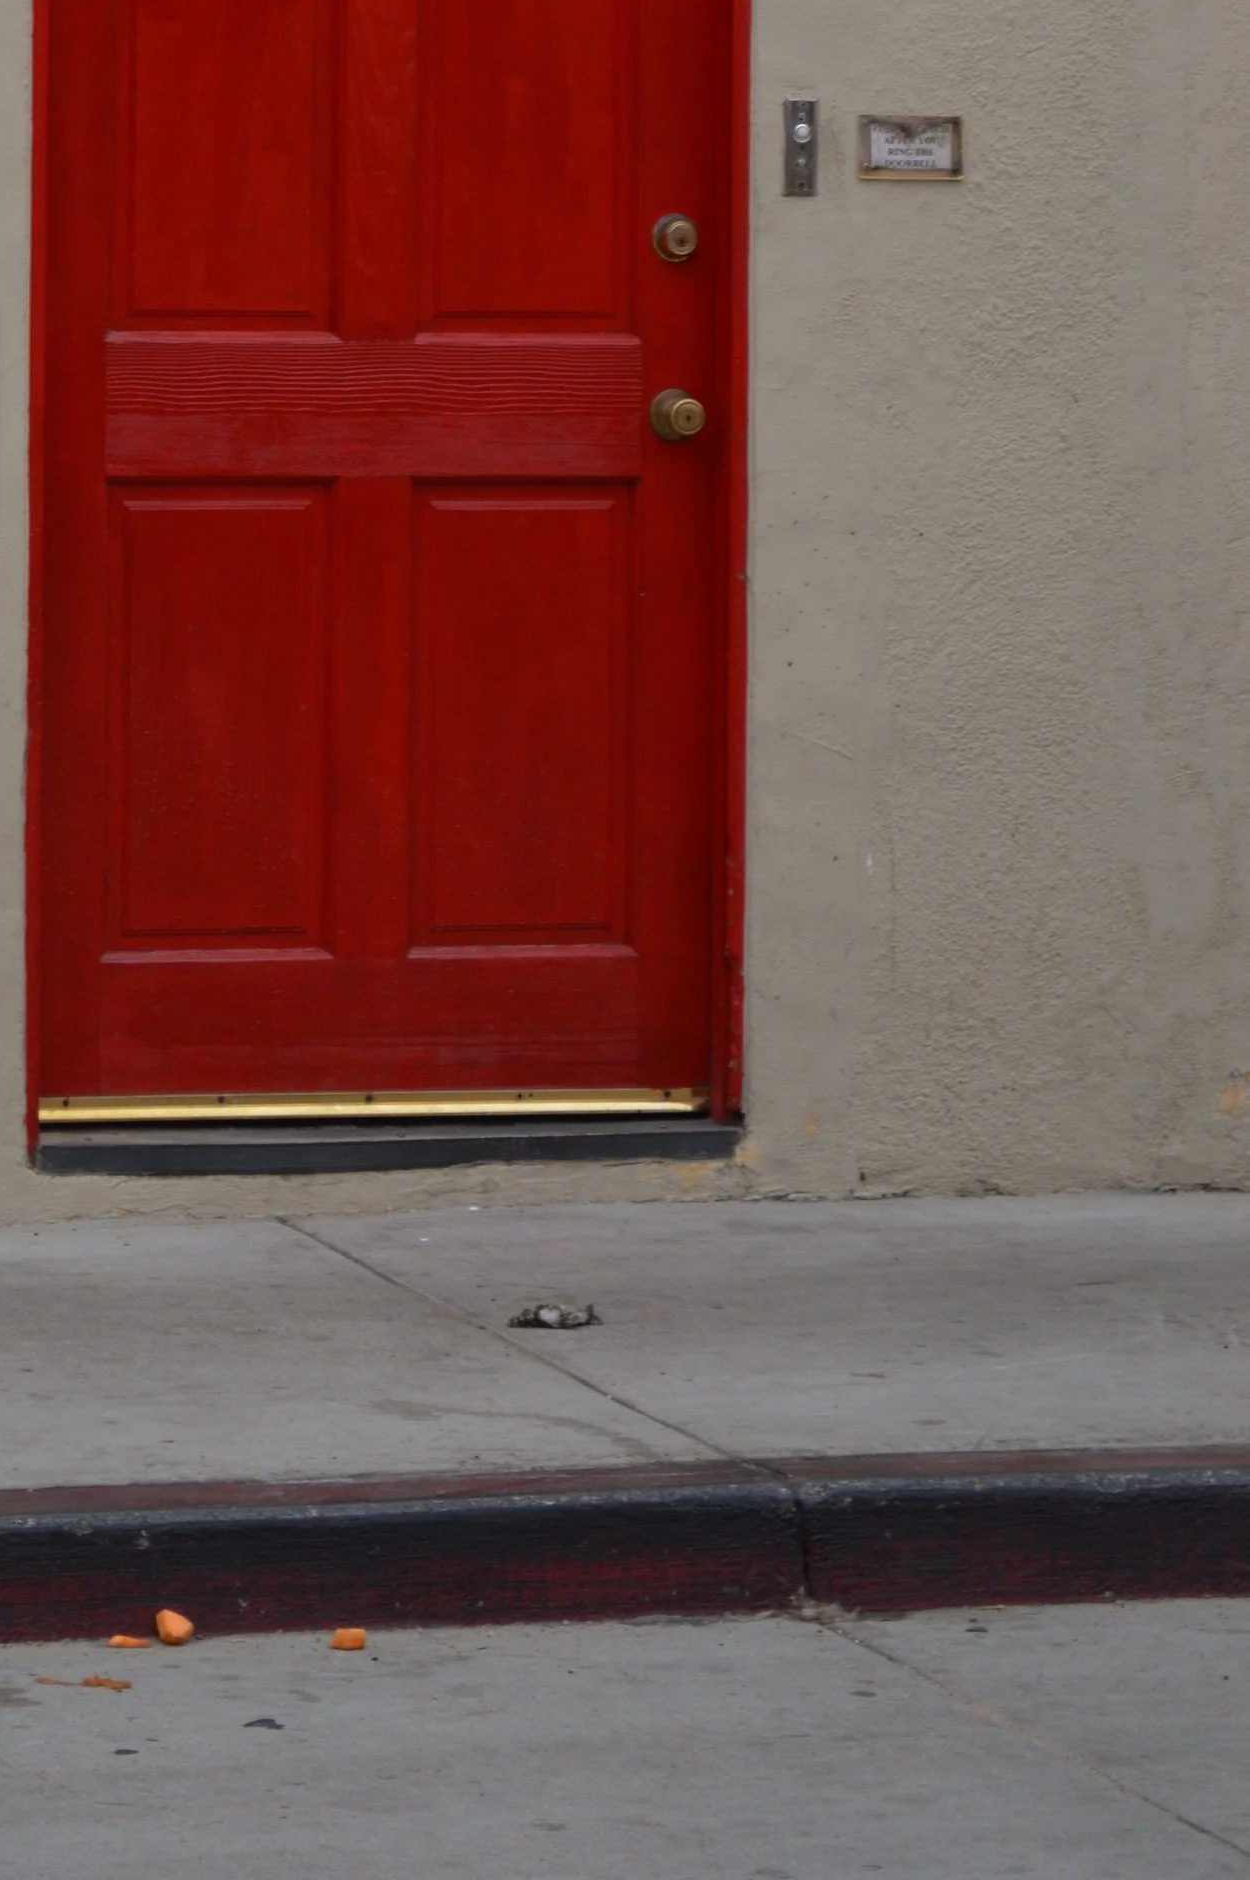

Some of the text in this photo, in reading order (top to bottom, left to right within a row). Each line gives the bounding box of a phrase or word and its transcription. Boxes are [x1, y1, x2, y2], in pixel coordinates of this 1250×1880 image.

[887, 148, 934, 156] RING THE
[885, 160, 937, 168] DOORBELL
